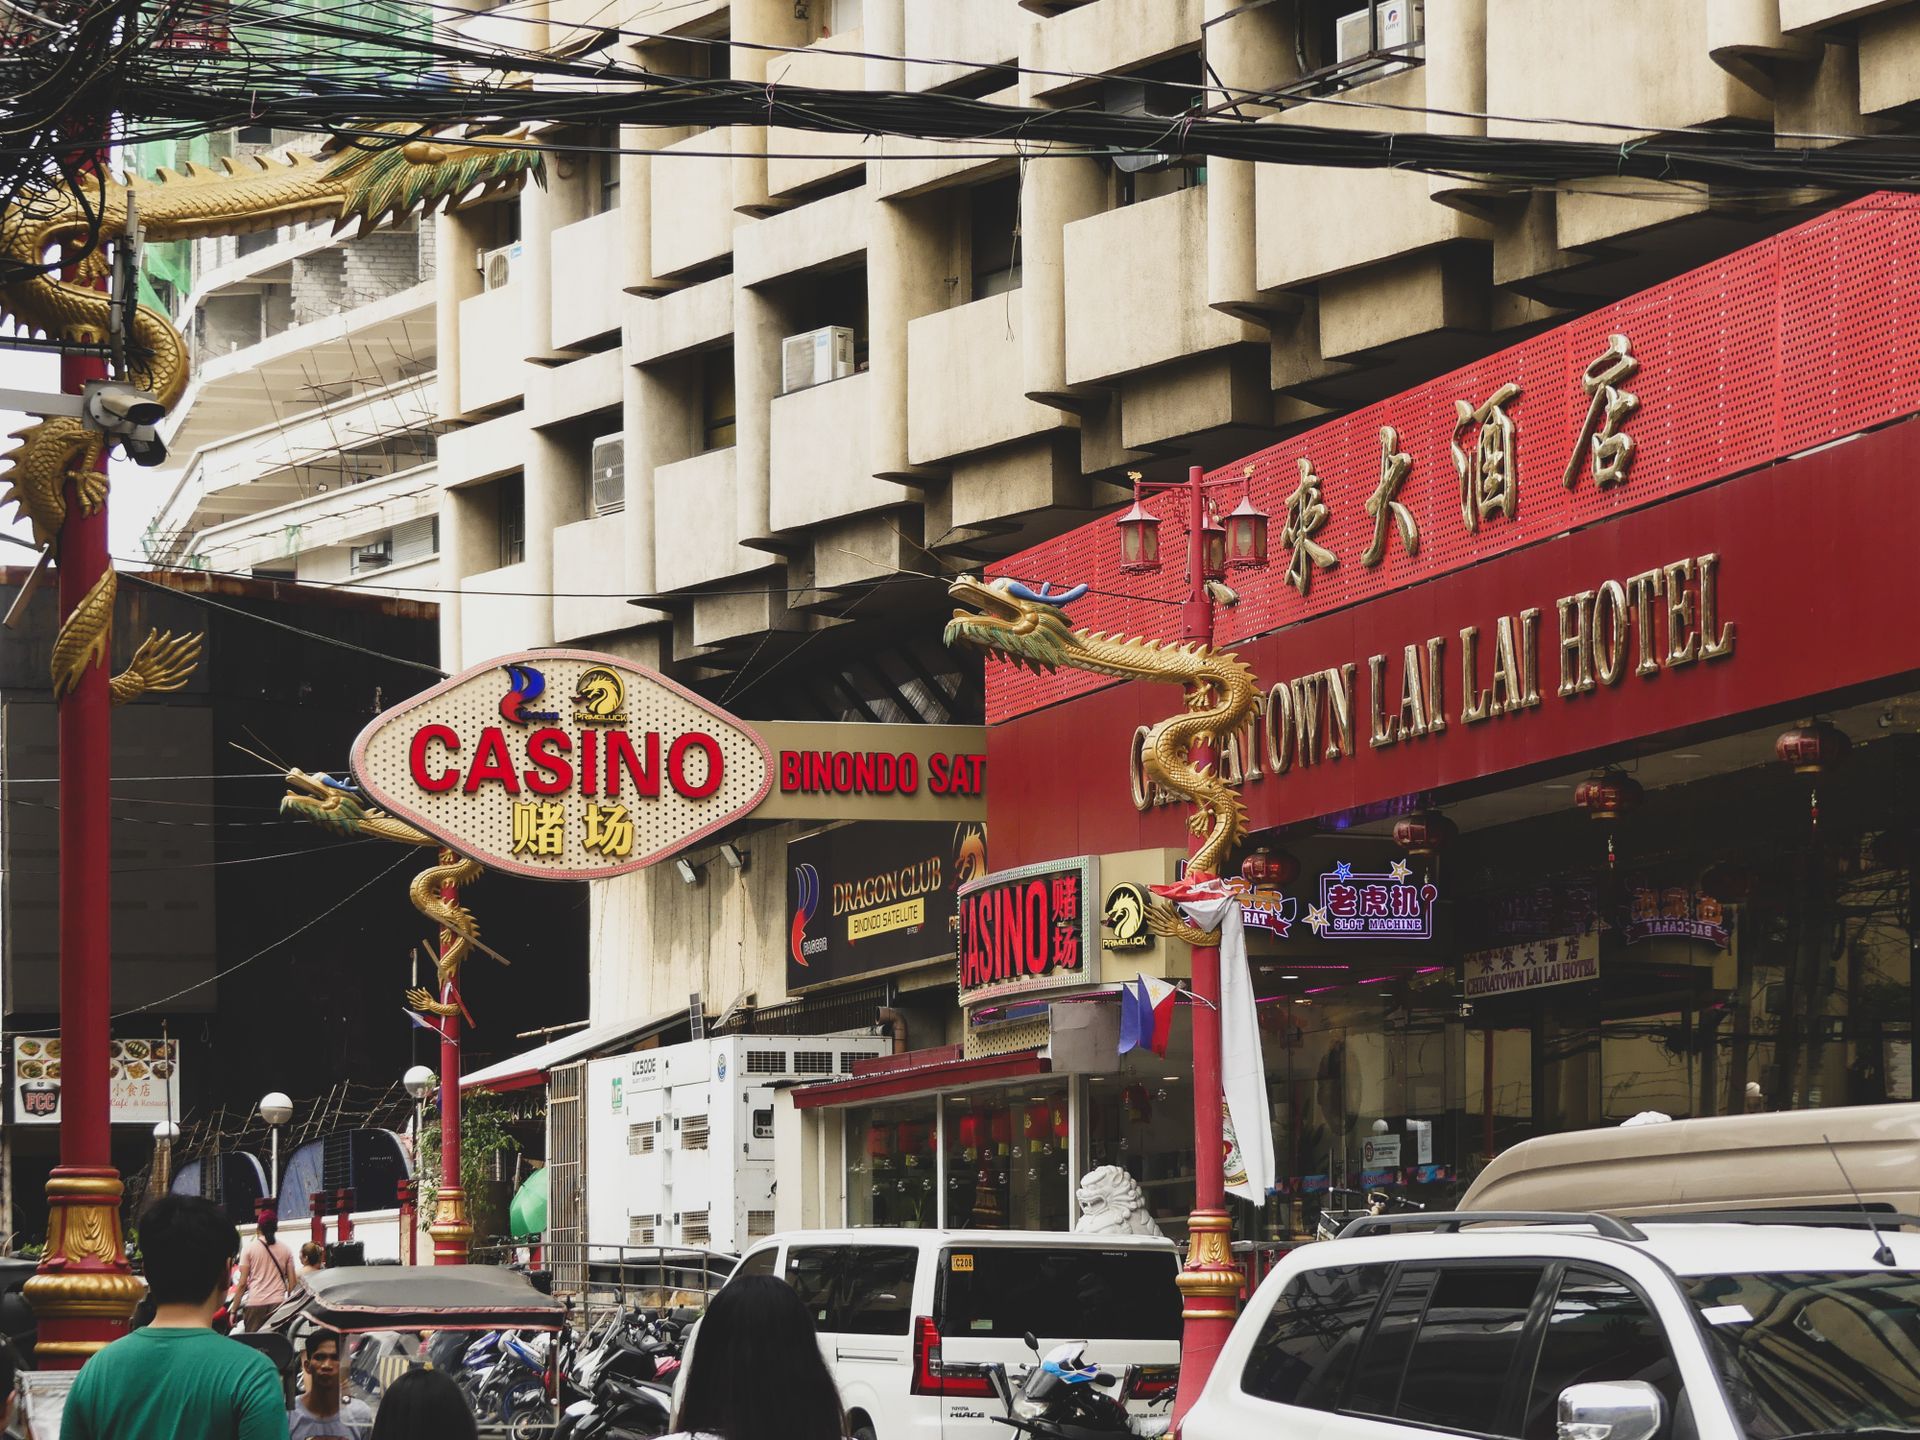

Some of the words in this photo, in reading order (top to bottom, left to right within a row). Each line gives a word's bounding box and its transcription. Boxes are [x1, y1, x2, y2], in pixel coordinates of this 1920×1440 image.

[1130, 662, 1356, 811] CATOWN
[1368, 636, 1446, 748] LAI
[1460, 608, 1541, 725] LAI
[1557, 553, 1734, 697] HOTEL
[409, 724, 725, 798] CASINO
[780, 750, 919, 793] BINONDO
[512, 801, 634, 856] 赌场
[832, 871, 898, 917] DRAGON
[900, 856, 942, 898] CLUB
[1327, 884, 1420, 917] 老虎机
[854, 913, 881, 934] BINONDO
[883, 904, 918, 927] SATELLITE
[960, 879, 1049, 989] CASINO
[1052, 875, 1077, 969] 赌场
[1334, 919, 1365, 931] SLOT
[1369, 918, 1422, 931] MACHINE
[1102, 935, 1148, 950] PRIMELUCK
[1466, 970, 1524, 995] CHINATOWN
[1526, 966, 1543, 986] LAI
[1544, 963, 1561, 983] LAI
[1562, 958, 1597, 980] HOTEL
[26, 1092, 56, 1111] FCC
